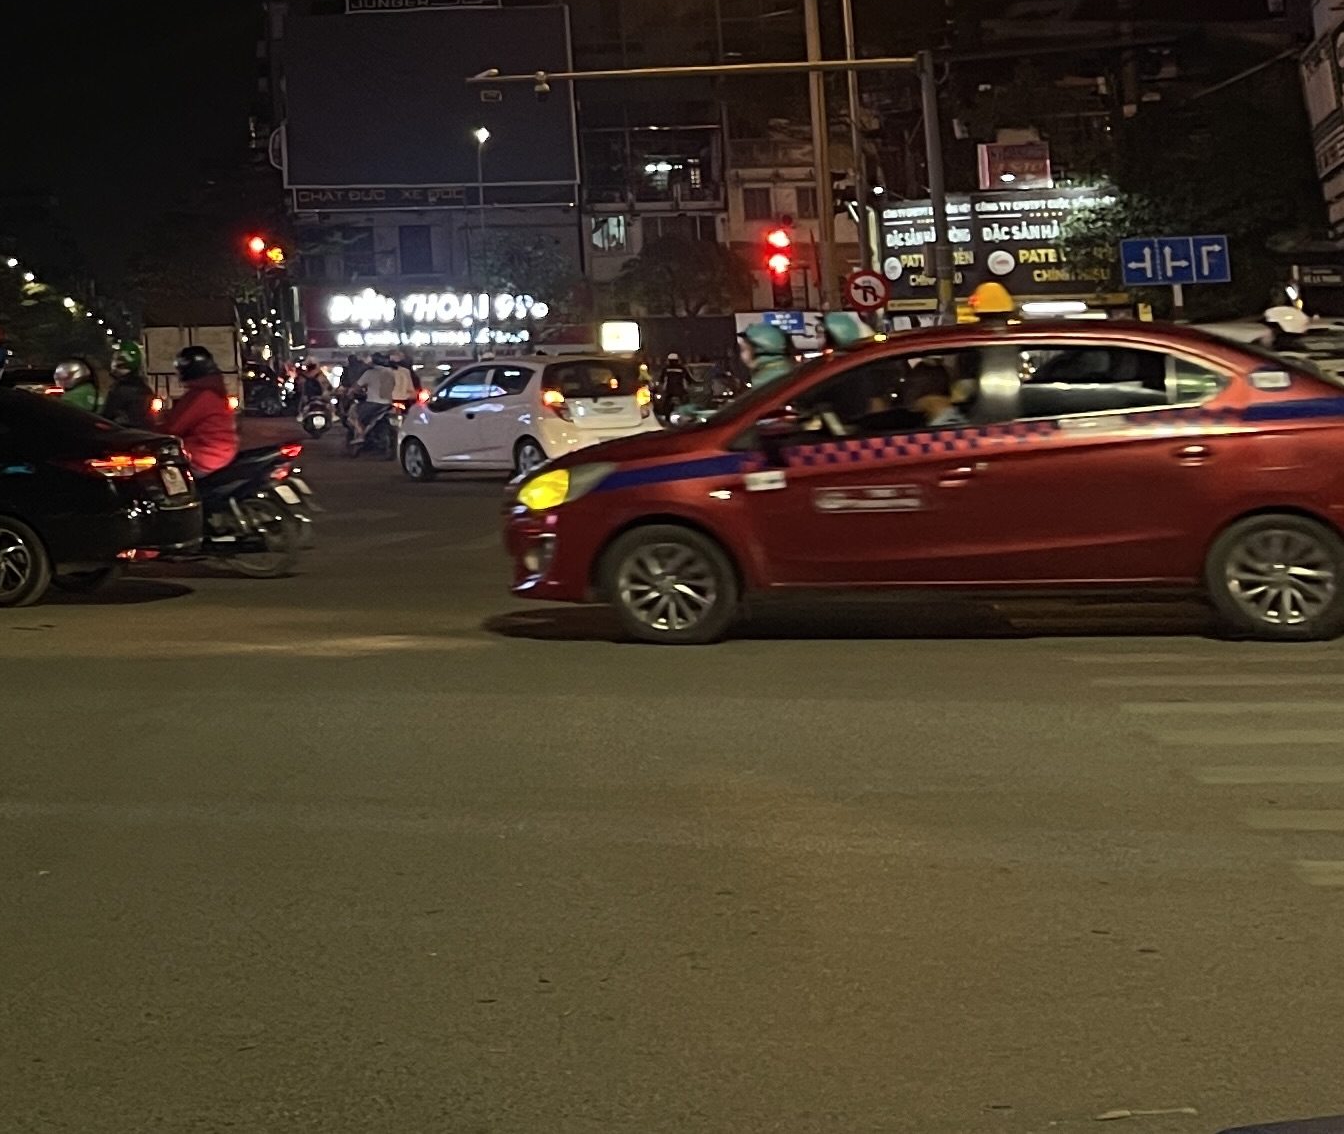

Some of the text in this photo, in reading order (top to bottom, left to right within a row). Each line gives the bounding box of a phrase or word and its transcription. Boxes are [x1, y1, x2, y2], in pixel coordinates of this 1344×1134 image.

[923, 226, 937, 243] HẢ
[981, 219, 1060, 243] ĐẶC SẢN HẢ
